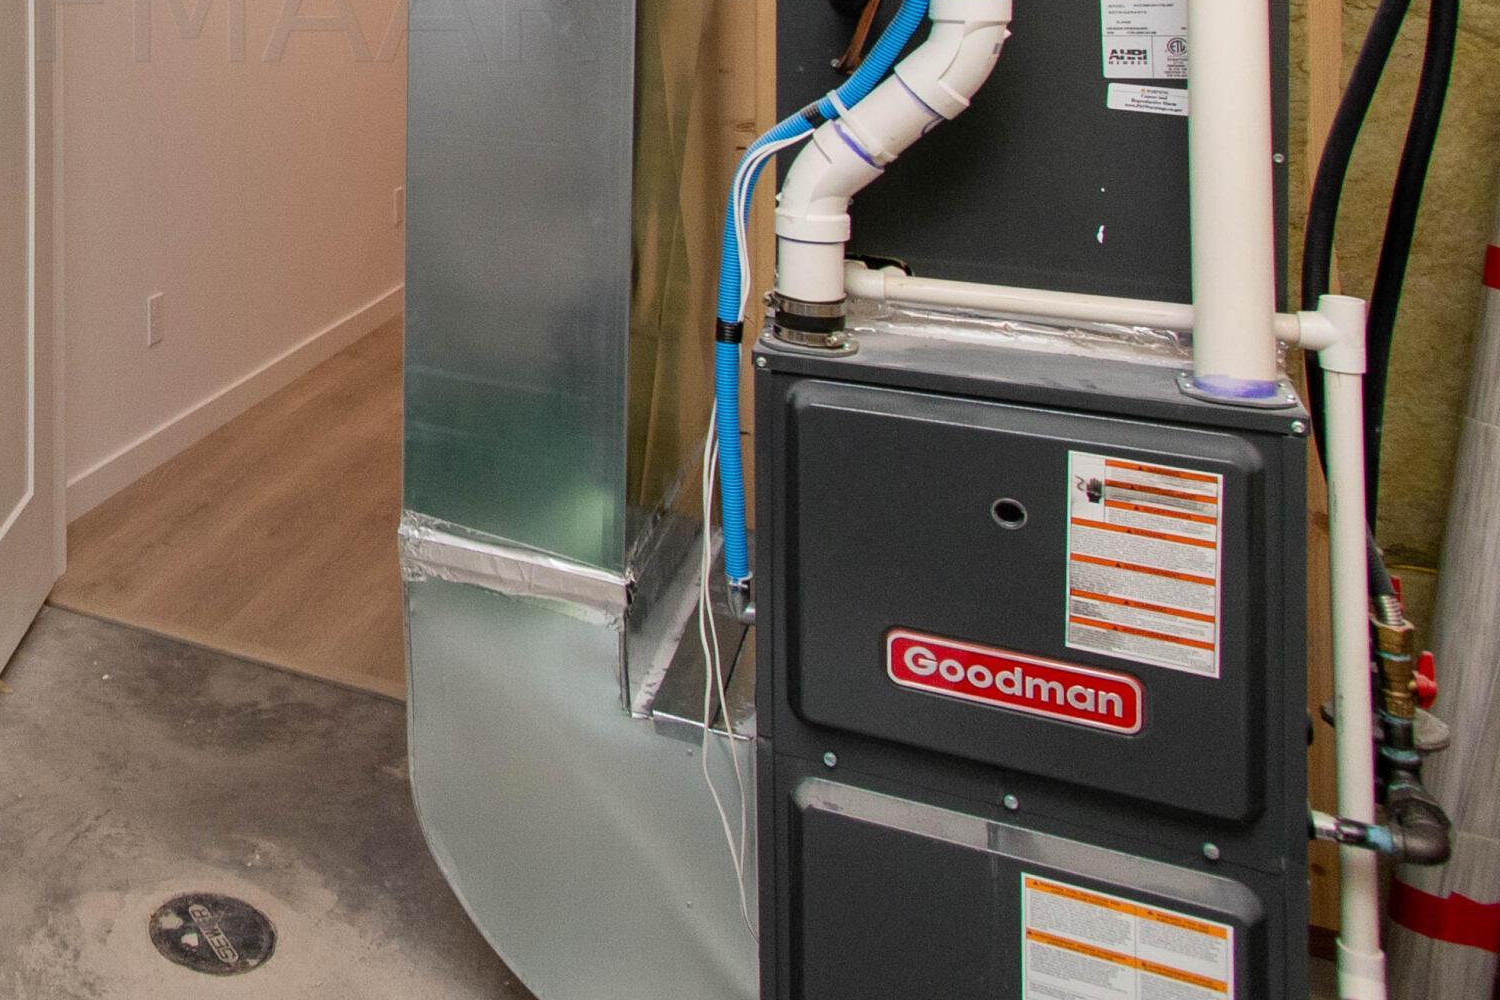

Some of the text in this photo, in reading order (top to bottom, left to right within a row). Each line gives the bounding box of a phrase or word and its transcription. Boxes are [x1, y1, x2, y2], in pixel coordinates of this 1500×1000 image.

[1108, 49, 1148, 60] AHRI
[903, 646, 1124, 717] Goodman
[191, 906, 237, 962] SEWR
